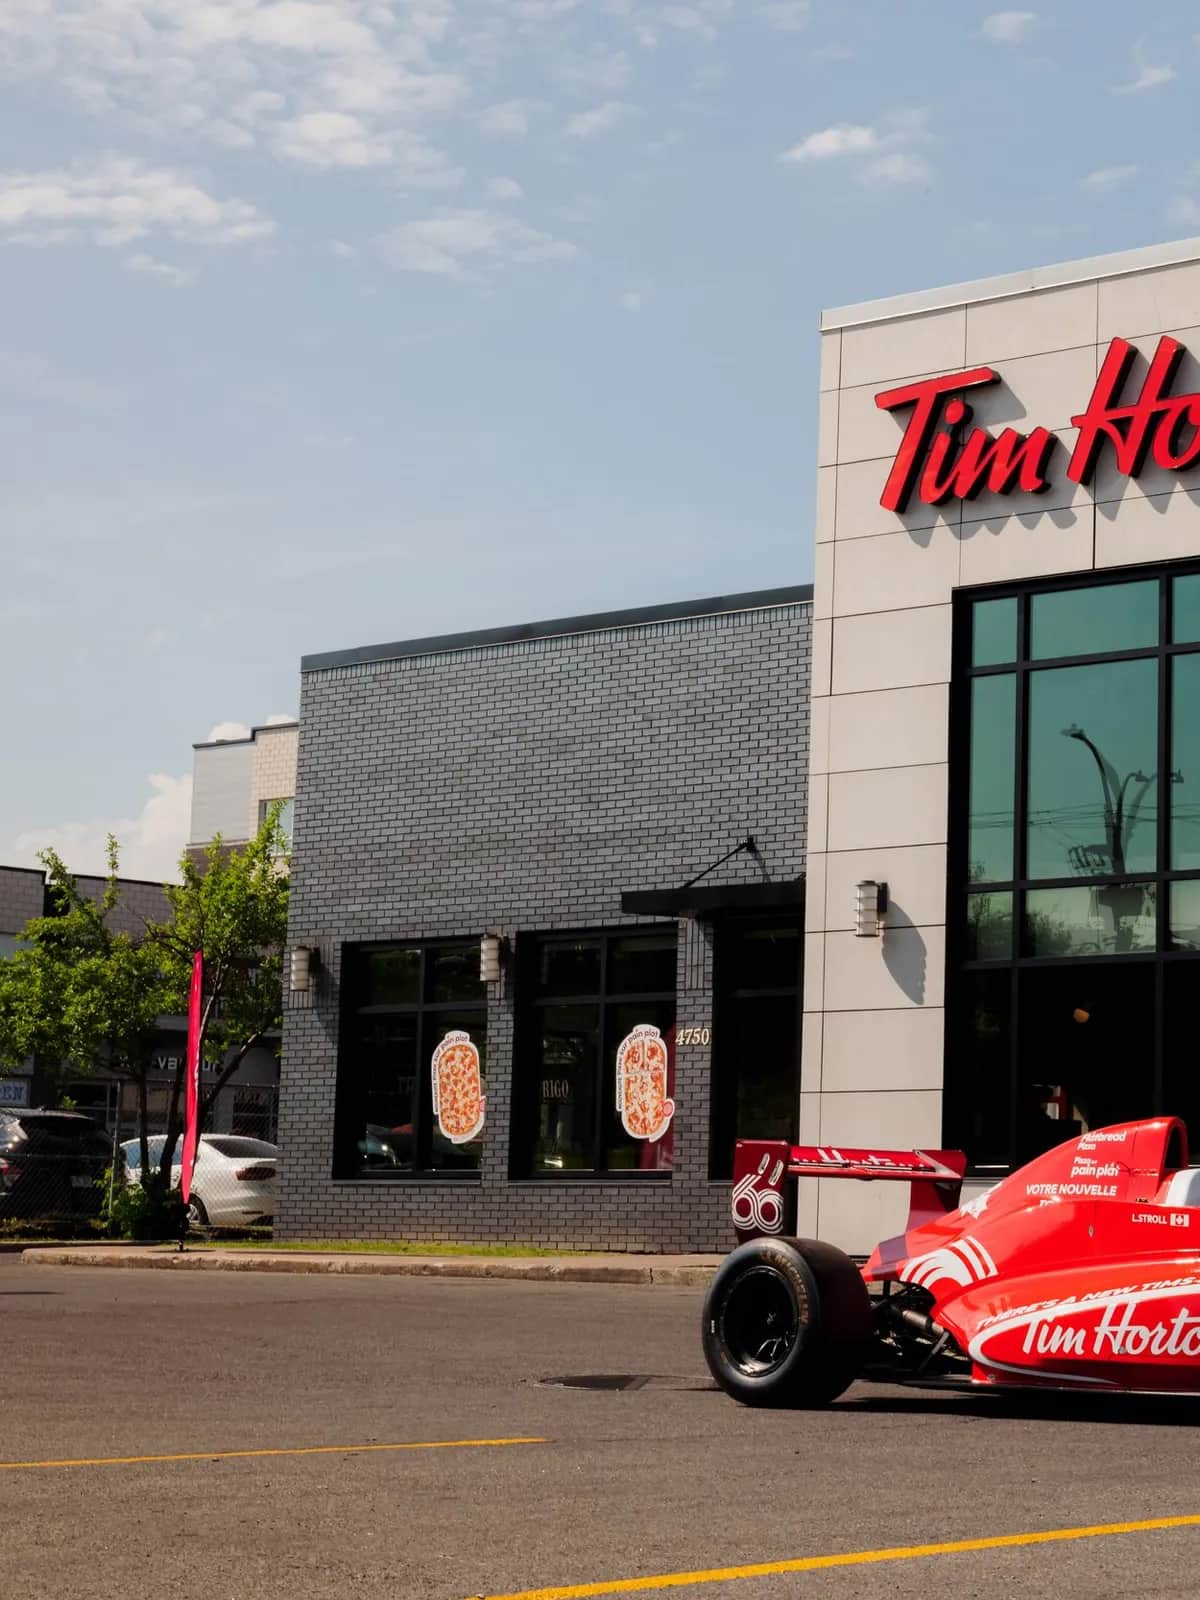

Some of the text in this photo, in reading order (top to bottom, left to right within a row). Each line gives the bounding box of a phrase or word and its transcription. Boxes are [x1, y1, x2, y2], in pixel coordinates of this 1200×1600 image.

[874, 366, 1058, 513] Tim
[675, 1028, 710, 1045] 4750
[1070, 1163, 1096, 1178] pain
[1026, 1183, 1118, 1196] VOTRE NOUVELLE
[976, 1298, 1060, 1329] THERE'S
[1060, 1296, 1076, 1304] A
[1081, 1285, 1138, 1302] NEW
[1022, 1311, 1087, 1355] Tim
